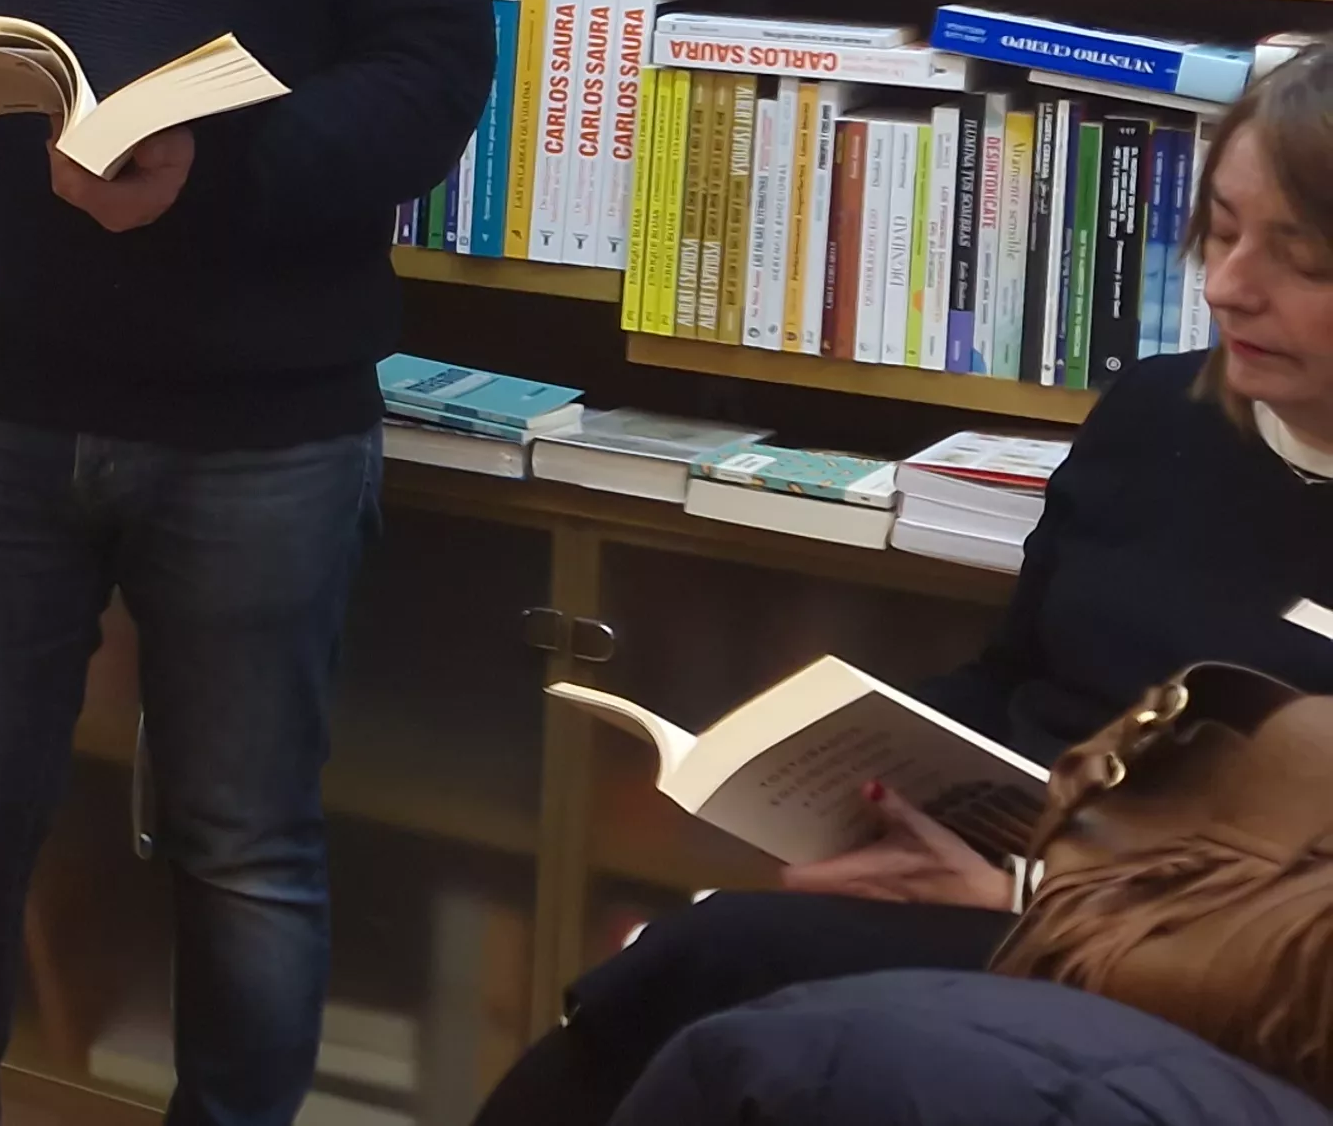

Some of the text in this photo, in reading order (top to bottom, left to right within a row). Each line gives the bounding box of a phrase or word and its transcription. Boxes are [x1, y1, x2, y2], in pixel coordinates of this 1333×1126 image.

[543, 4, 576, 154] CARLOS SAURA
[578, 7, 611, 157] CARLOS SAURA
[612, 8, 645, 160] CARLOS SAURA
[670, 40, 839, 72] CARLOS SAURA
[1000, 34, 1156, 74] NUESTRO CUERPO
[516, 138, 529, 188] PALABRAS
[729, 86, 754, 175] ALBERT ESPINOSA
[771, 164, 787, 281] HERENCIA EMOCIONAL
[957, 119, 978, 247] ILUMINA TUS SOMBRAS
[1005, 140, 1027, 262] Altamente sensible
[677, 238, 699, 326] ALBERT ESPINOSA
[754, 226, 767, 252] FALSAS
[889, 215, 907, 287] DIGNIDAD
[699, 241, 722, 329] ALBERT ESPINOSA
